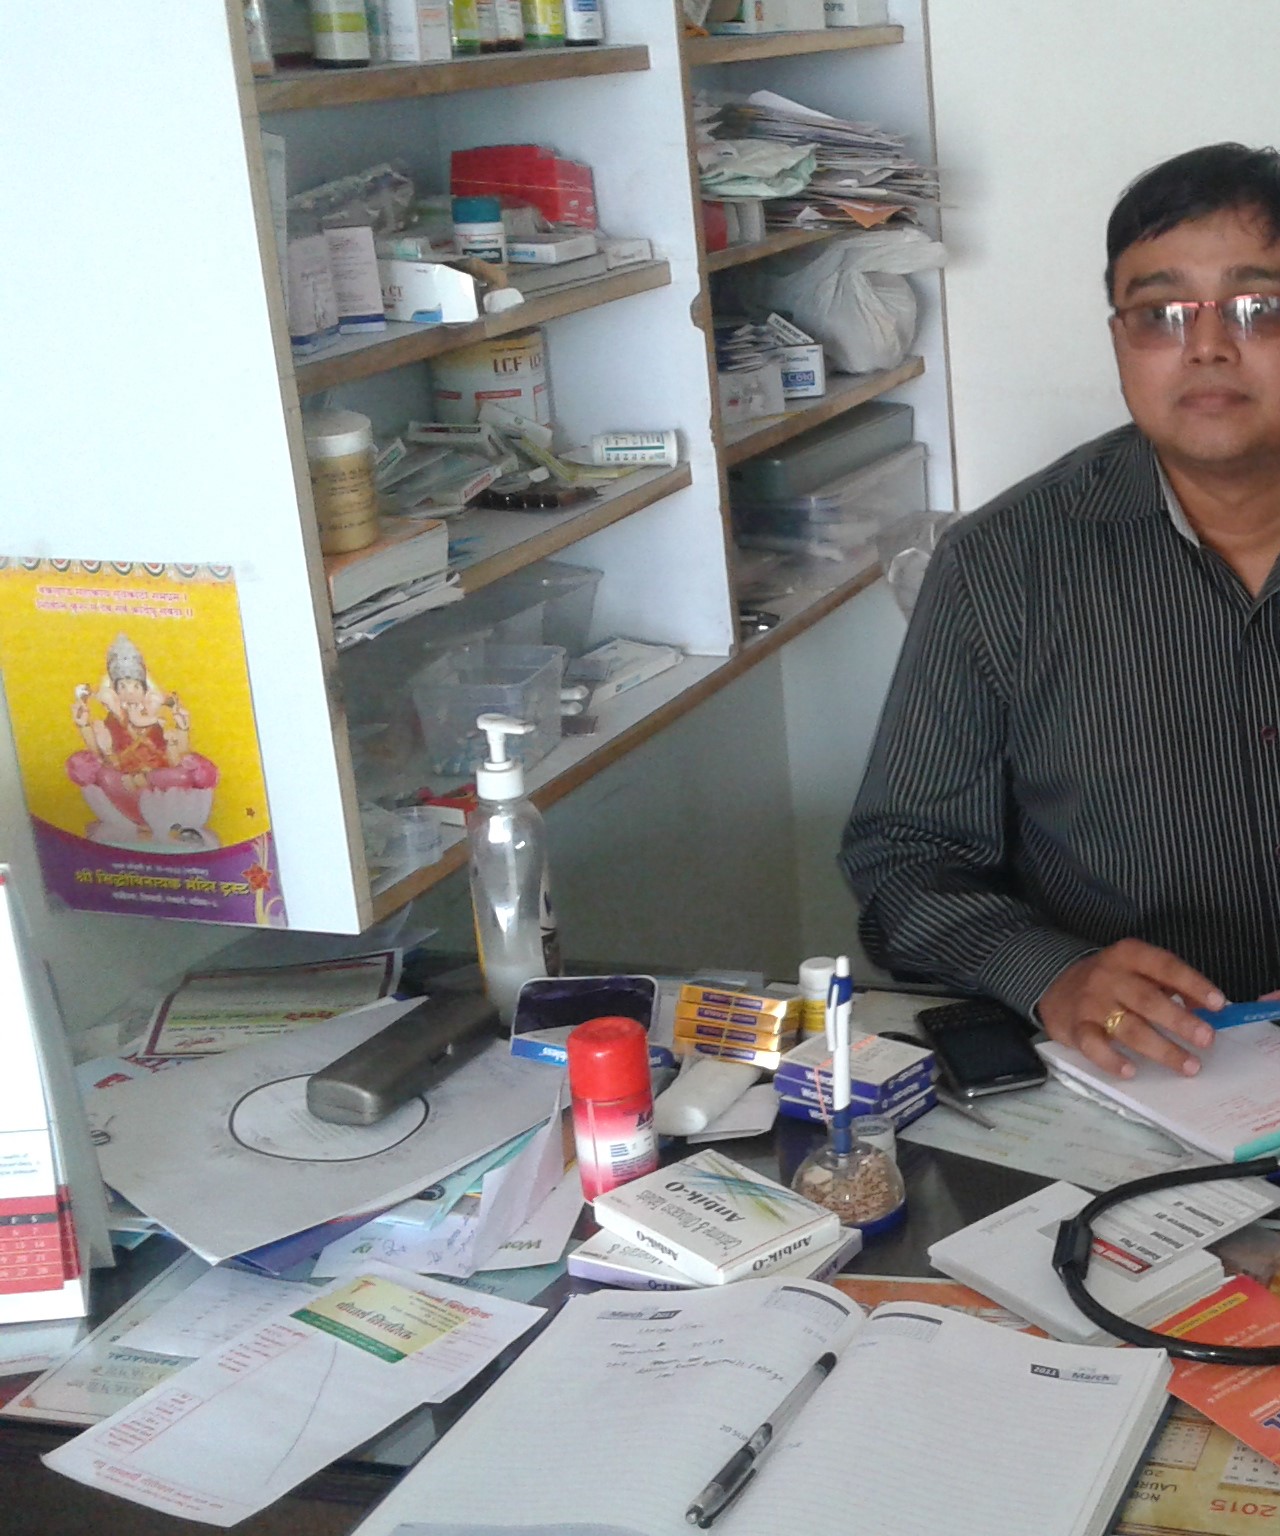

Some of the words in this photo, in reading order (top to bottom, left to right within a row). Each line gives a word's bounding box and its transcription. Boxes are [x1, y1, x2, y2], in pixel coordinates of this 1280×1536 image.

[752, 1234, 813, 1272] Anbik-O
[1071, 1372, 1111, 1381] March
[1209, 1498, 1278, 1518] 2015
